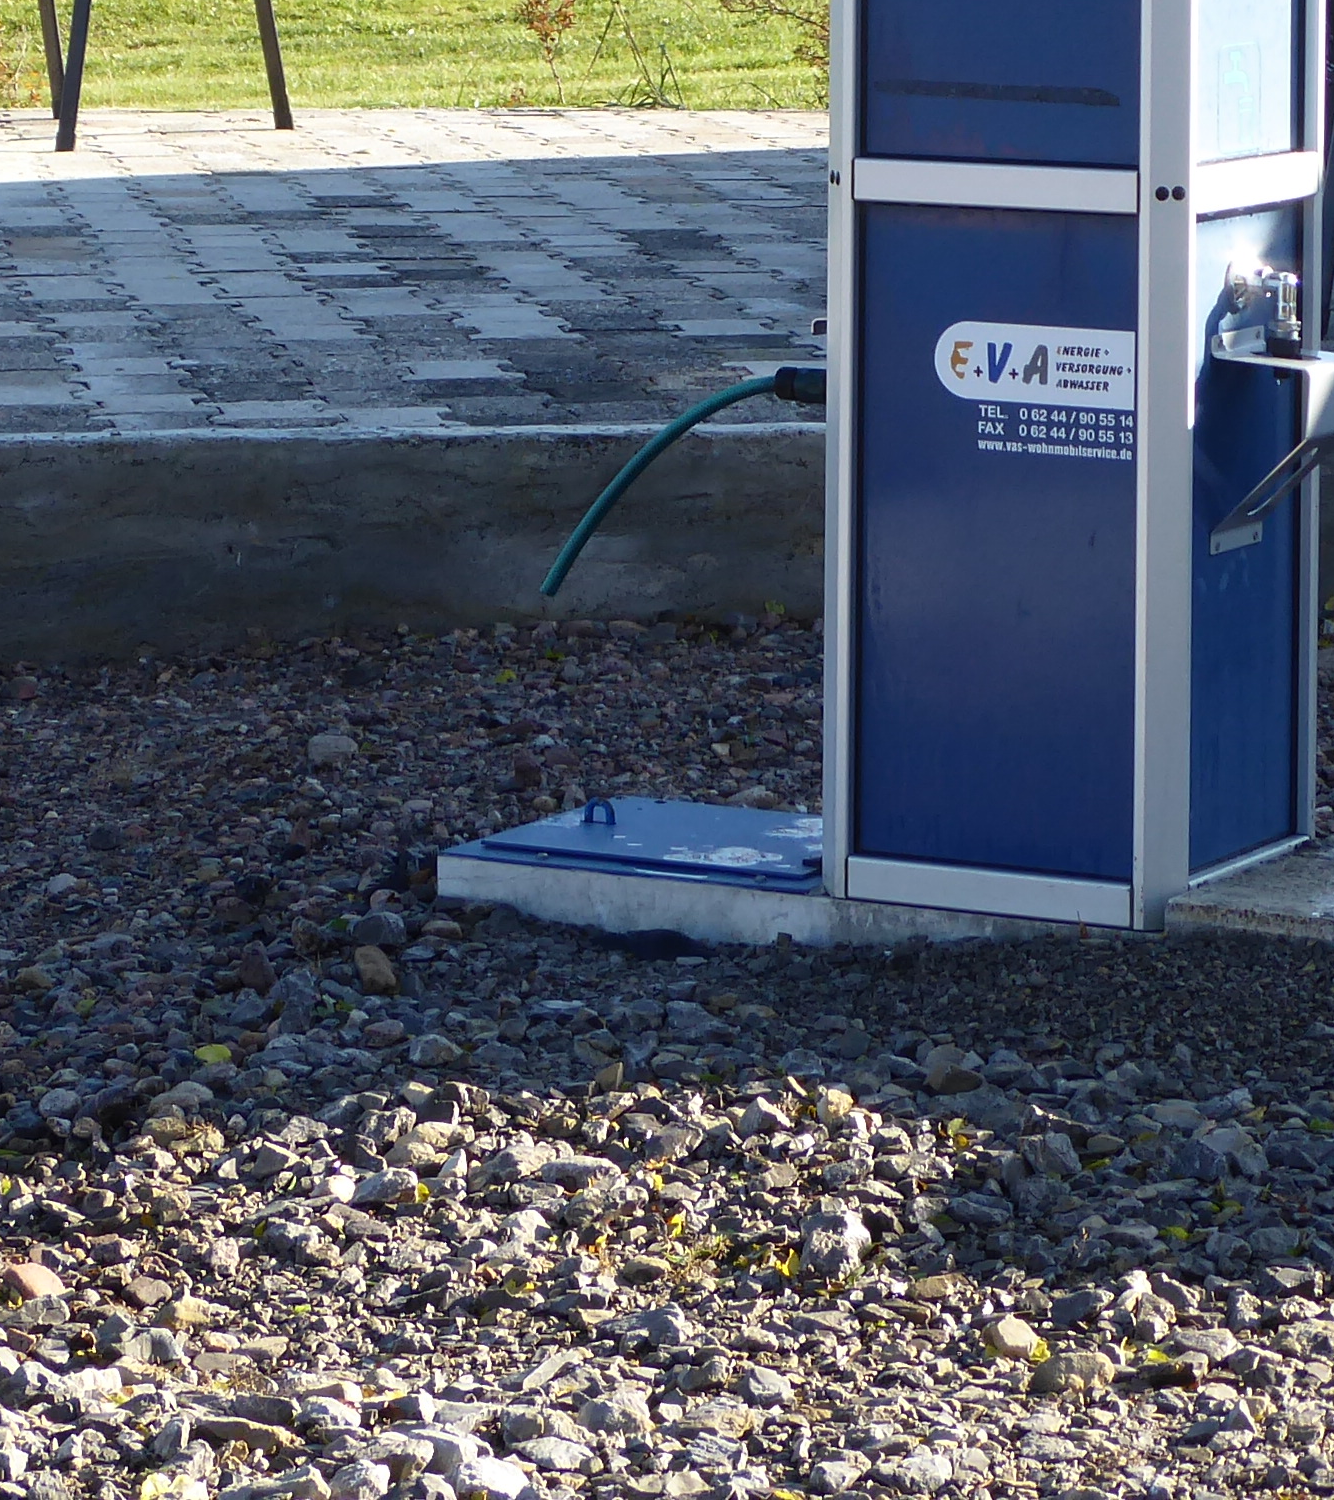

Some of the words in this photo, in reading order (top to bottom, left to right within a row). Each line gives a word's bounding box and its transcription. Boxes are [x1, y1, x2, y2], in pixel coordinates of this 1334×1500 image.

[1056, 346, 1101, 358] ENERGIE
[1055, 362, 1124, 376] VERSORGUNG
[1056, 379, 1109, 393] ABWASSER
[1019, 408, 1028, 420] 0
[1031, 409, 1047, 422] 62
[1050, 410, 1067, 423] 44
[1079, 412, 1095, 425] 90
[1099, 413, 1115, 426] 55
[1119, 414, 1134, 428] 14
[978, 421, 1004, 435] FAX
[1019, 424, 1027, 436] 0
[1030, 425, 1046, 438] 62
[1050, 426, 1066, 439] 44
[1078, 429, 1095, 442] 90
[1098, 430, 1115, 443] 55
[1119, 431, 1133, 444] 13
[977, 439, 1132, 460] www.vas-wohnmobilservice.de
